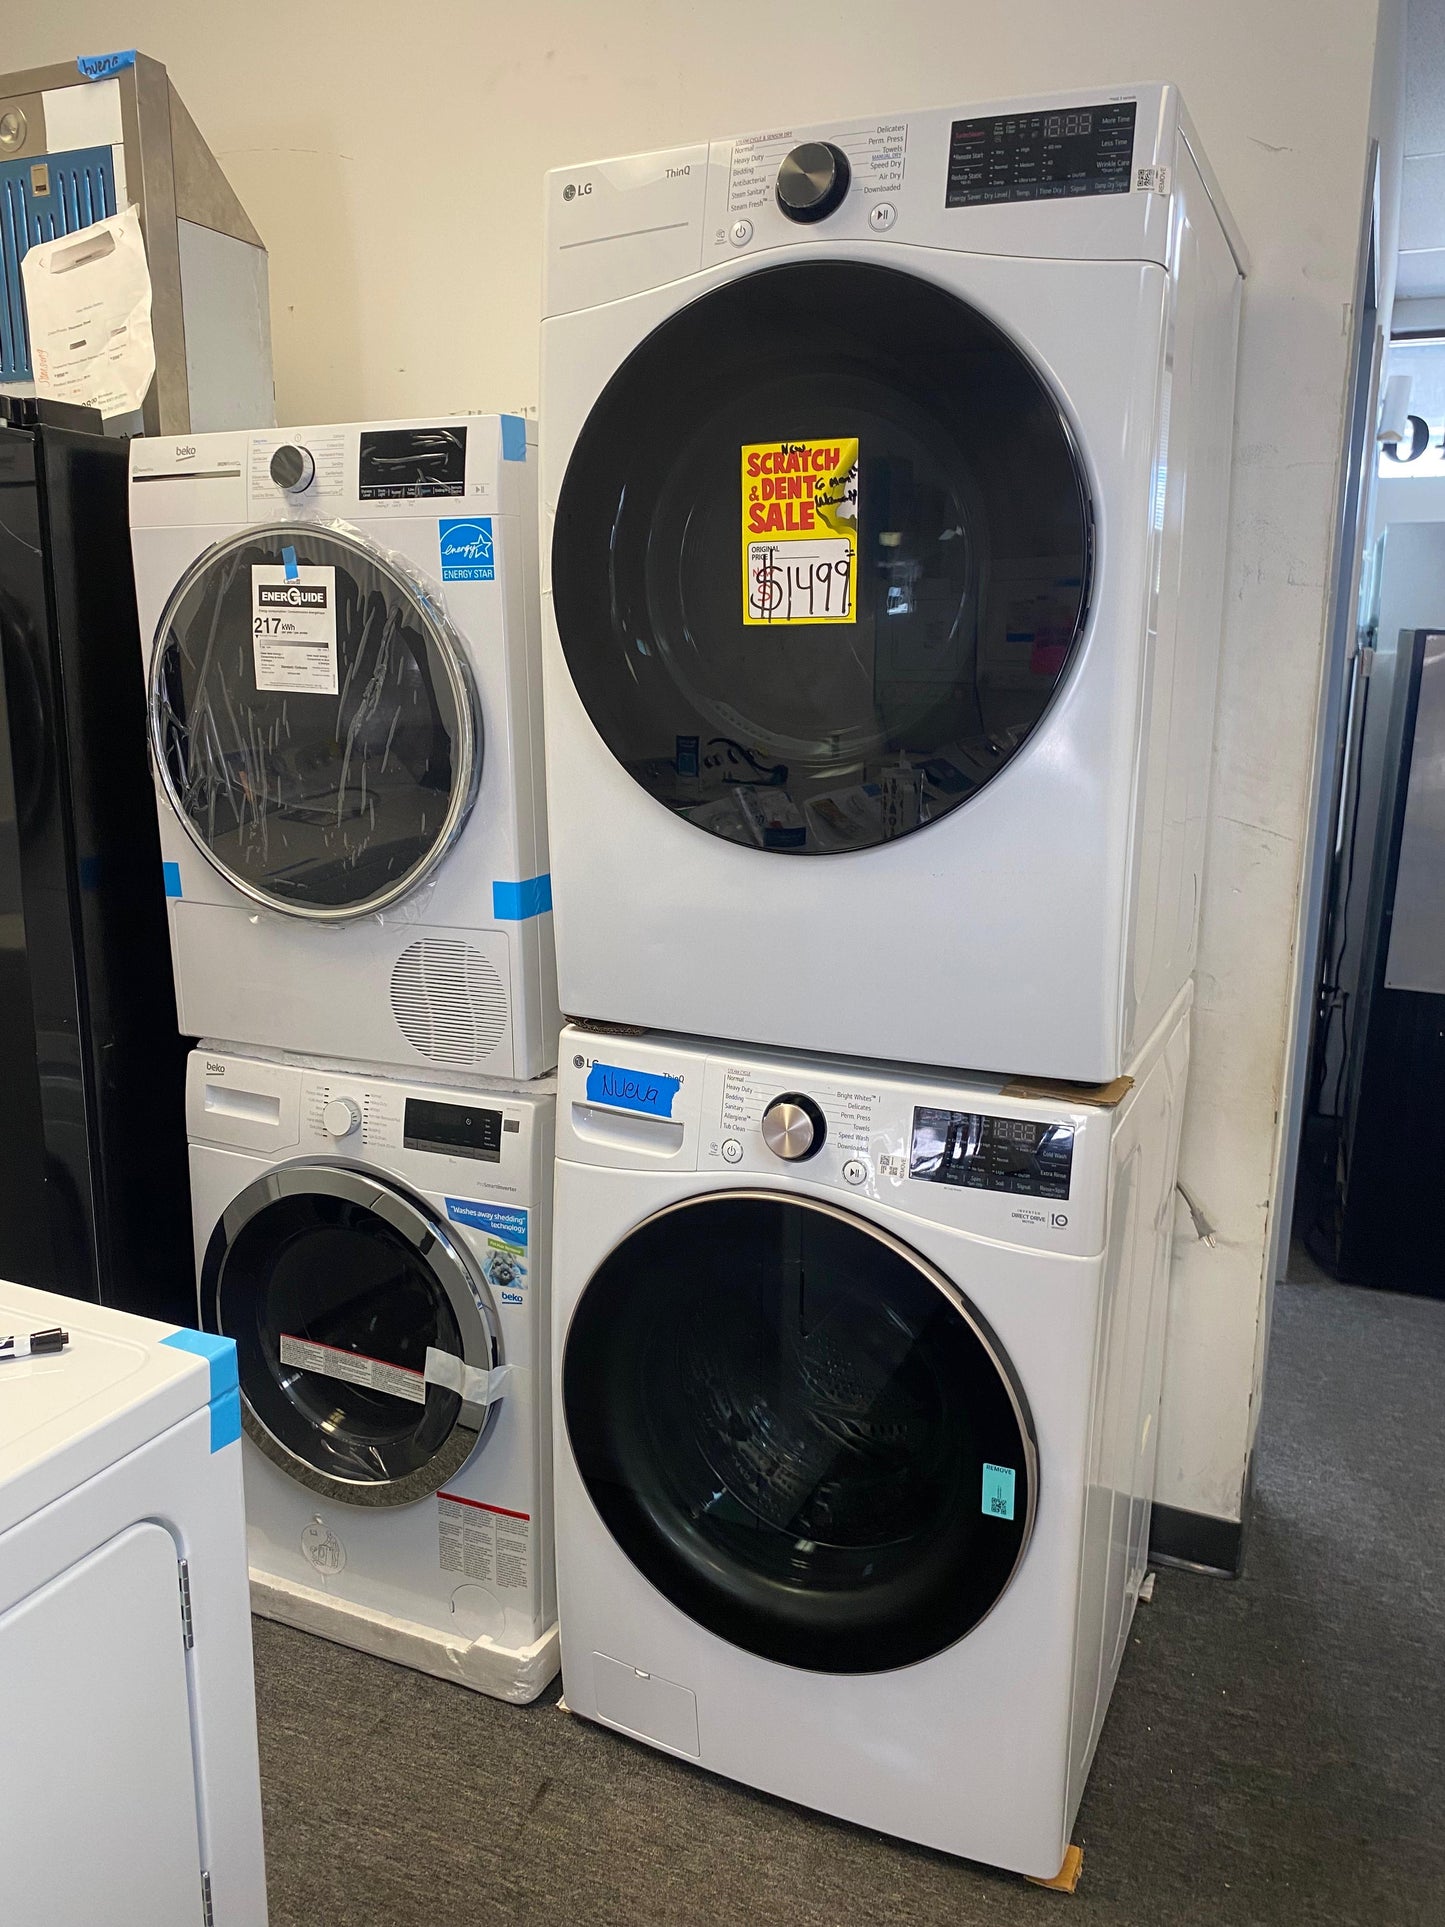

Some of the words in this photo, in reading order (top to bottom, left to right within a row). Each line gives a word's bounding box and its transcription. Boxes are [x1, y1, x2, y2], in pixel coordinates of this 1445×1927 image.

[877, 125, 904, 133] Delicates
[734, 145, 754, 154] Normal
[882, 145, 903, 153] Towels
[870, 161, 889, 170] Speed
[665, 165, 690, 178] ThinQ
[733, 167, 754, 176] Bedding
[732, 176, 766, 188] Antibacterial
[578, 183, 592, 196] LG
[864, 184, 901, 194] Downloaded
[731, 204, 747, 212] Steam
[176, 446, 196, 456] beko
[747, 447, 840, 477] SCRATCH
[749, 485, 760, 501] &
[761, 475, 816, 501] DENT
[748, 501, 815, 534] SALE
[442, 544, 477, 559] energy
[444, 570, 472, 579] ENERGY
[474, 569, 493, 578] STAR
[262, 587, 324, 605] ENERGUIDE
[254, 617, 281, 634] 217
[206, 1061, 225, 1072] beko
[602, 1072, 659, 1104] Nueva
[726, 1093, 744, 1103] Bedding
[836, 1092, 852, 1100] Bright
[725, 1103, 744, 1112] Sanitary
[848, 1103, 871, 1111] Delicates
[838, 1132, 854, 1140] Speed
[838, 1143, 868, 1152] Downloaded
[477, 1211, 493, 1220] away
[1051, 1213, 1068, 1226] 10
[491, 1222, 525, 1234] technology
[502, 1292, 523, 1302] beko
[986, 1464, 1012, 1475] REMOVE
